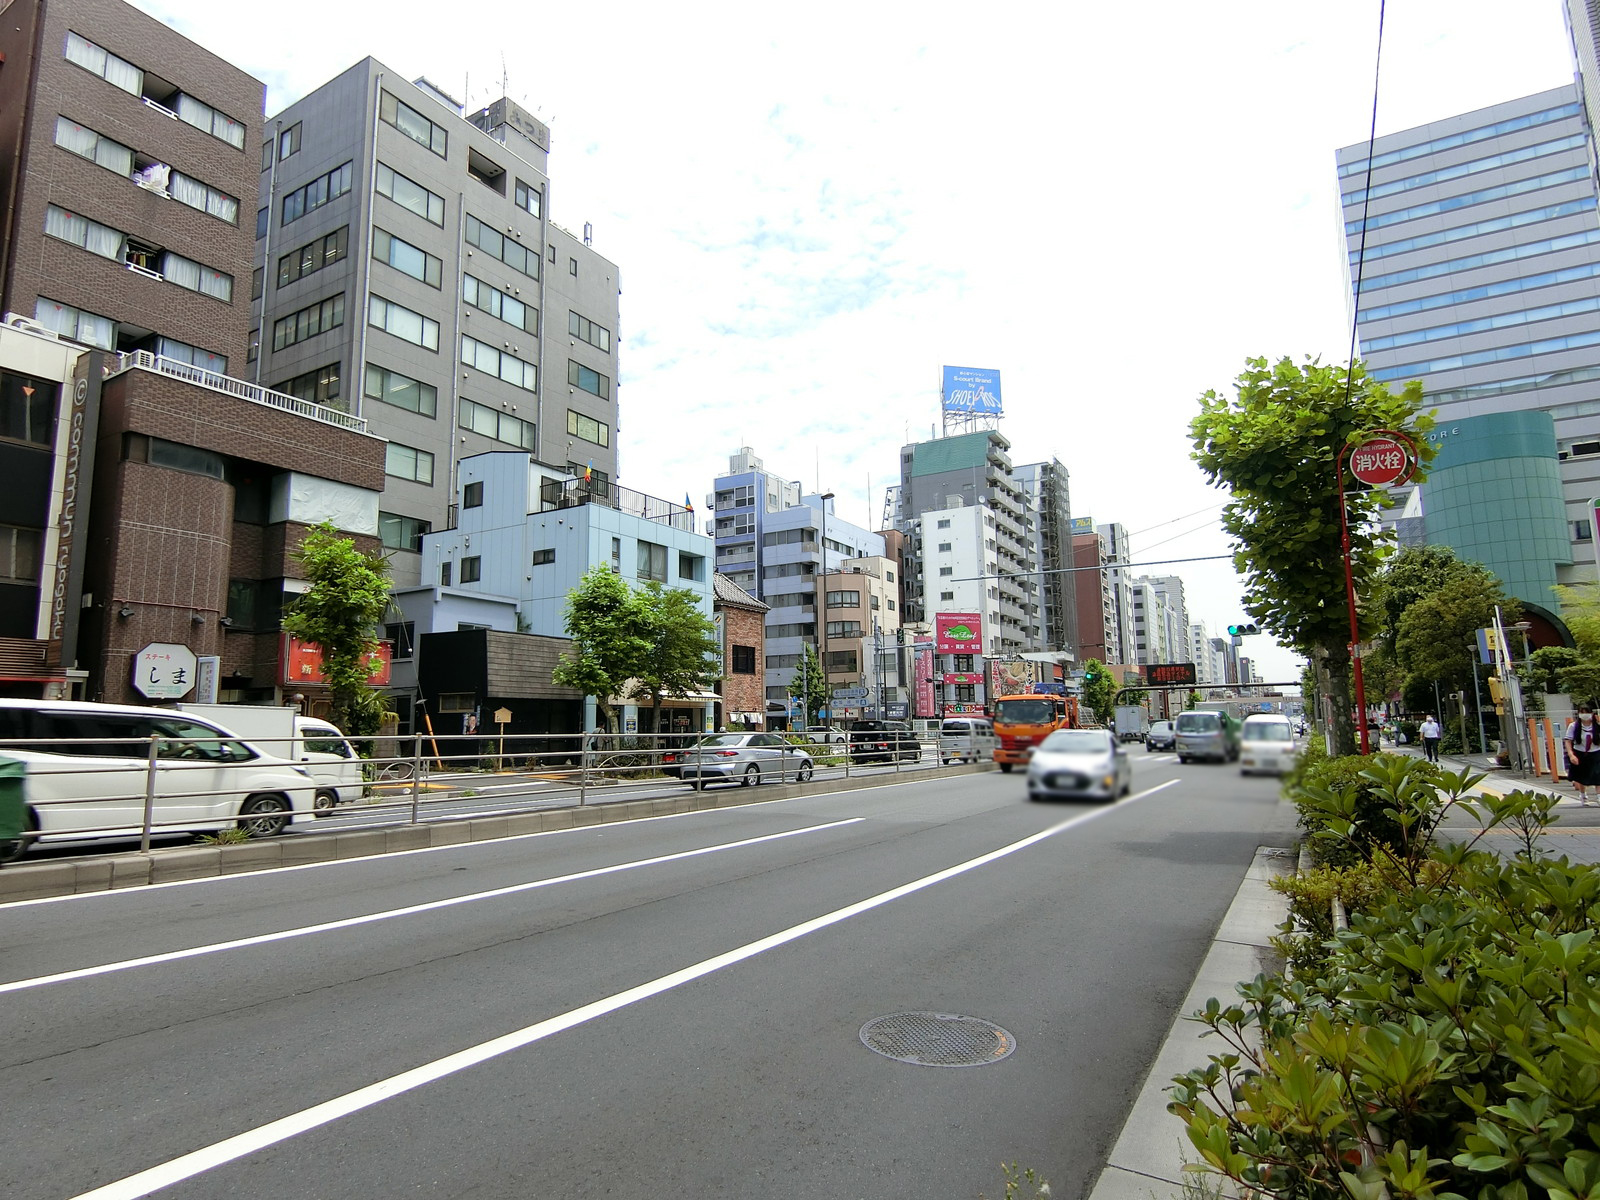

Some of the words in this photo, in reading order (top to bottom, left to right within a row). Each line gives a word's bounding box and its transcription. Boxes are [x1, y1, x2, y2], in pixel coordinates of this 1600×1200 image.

[1371, 443, 1396, 451] HYDRANT
[1355, 450, 1401, 473] 消火栓
[61, 412, 83, 538] commun
[51, 545, 71, 640] ryogoku
[145, 653, 172, 661] ステーキ
[149, 666, 188, 685] しま
